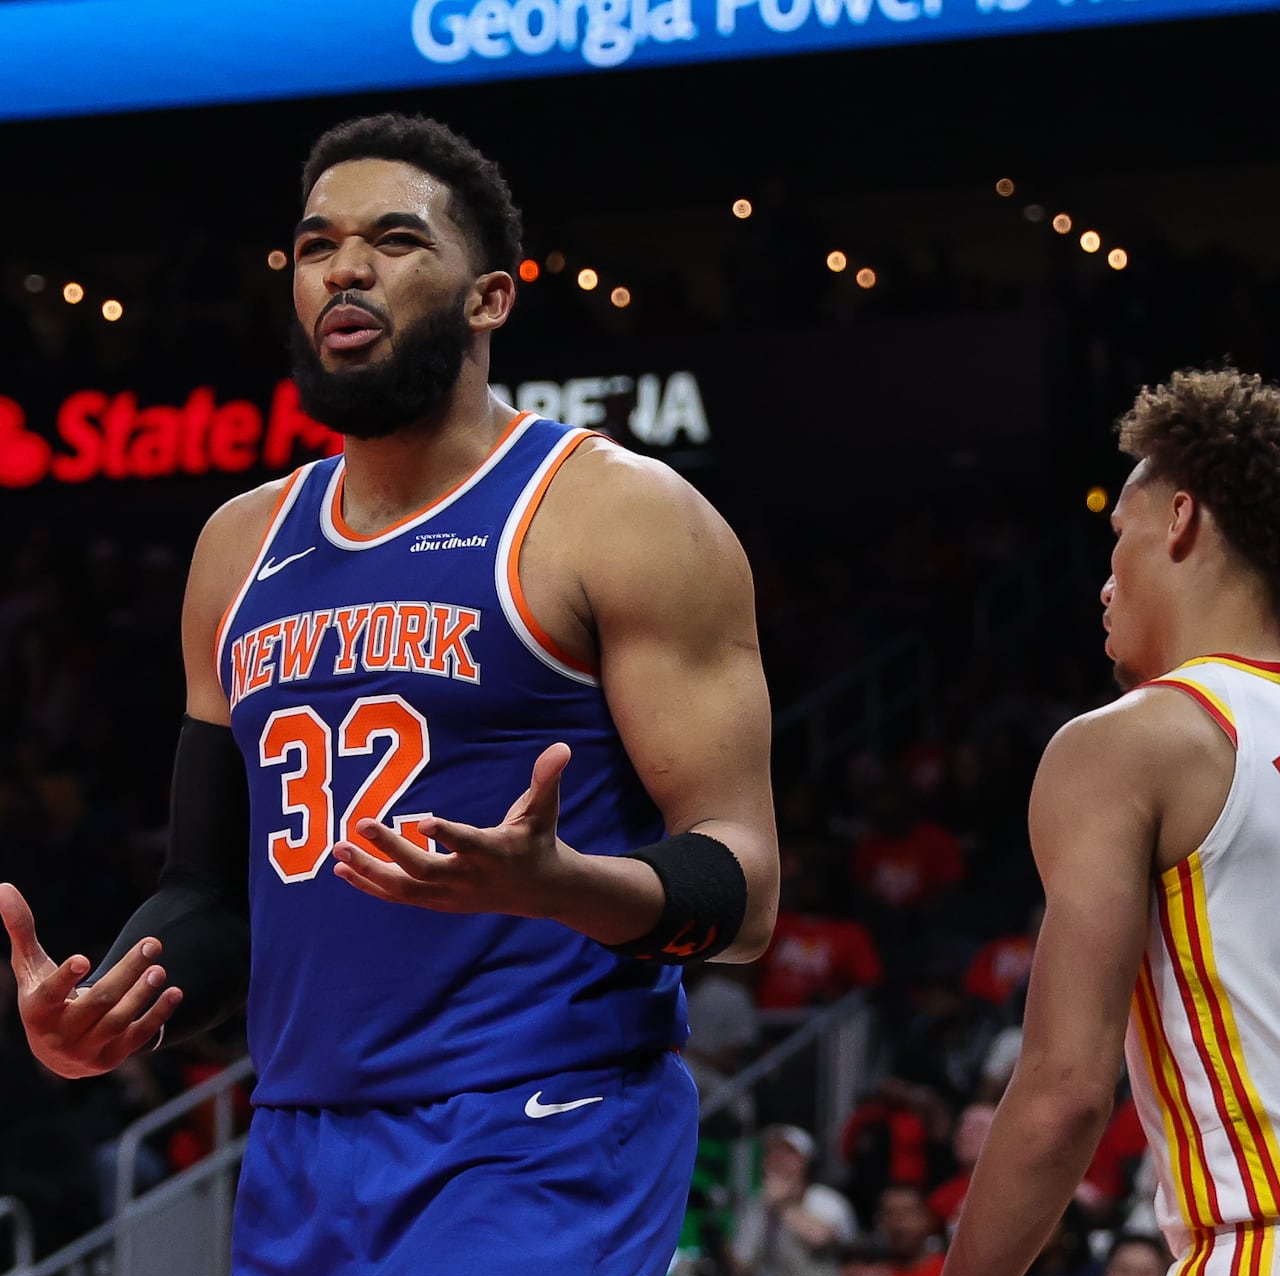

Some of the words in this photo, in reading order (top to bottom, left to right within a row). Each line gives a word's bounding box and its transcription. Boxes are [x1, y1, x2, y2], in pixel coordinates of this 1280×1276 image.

[410, 0, 698, 67] Georgia
[52, 385, 262, 483] State
[409, 540, 441, 553] abu
[441, 535, 489, 550] dhabi
[229, 608, 334, 715] NEW
[333, 600, 483, 686] YORK
[258, 694, 438, 885] 32
